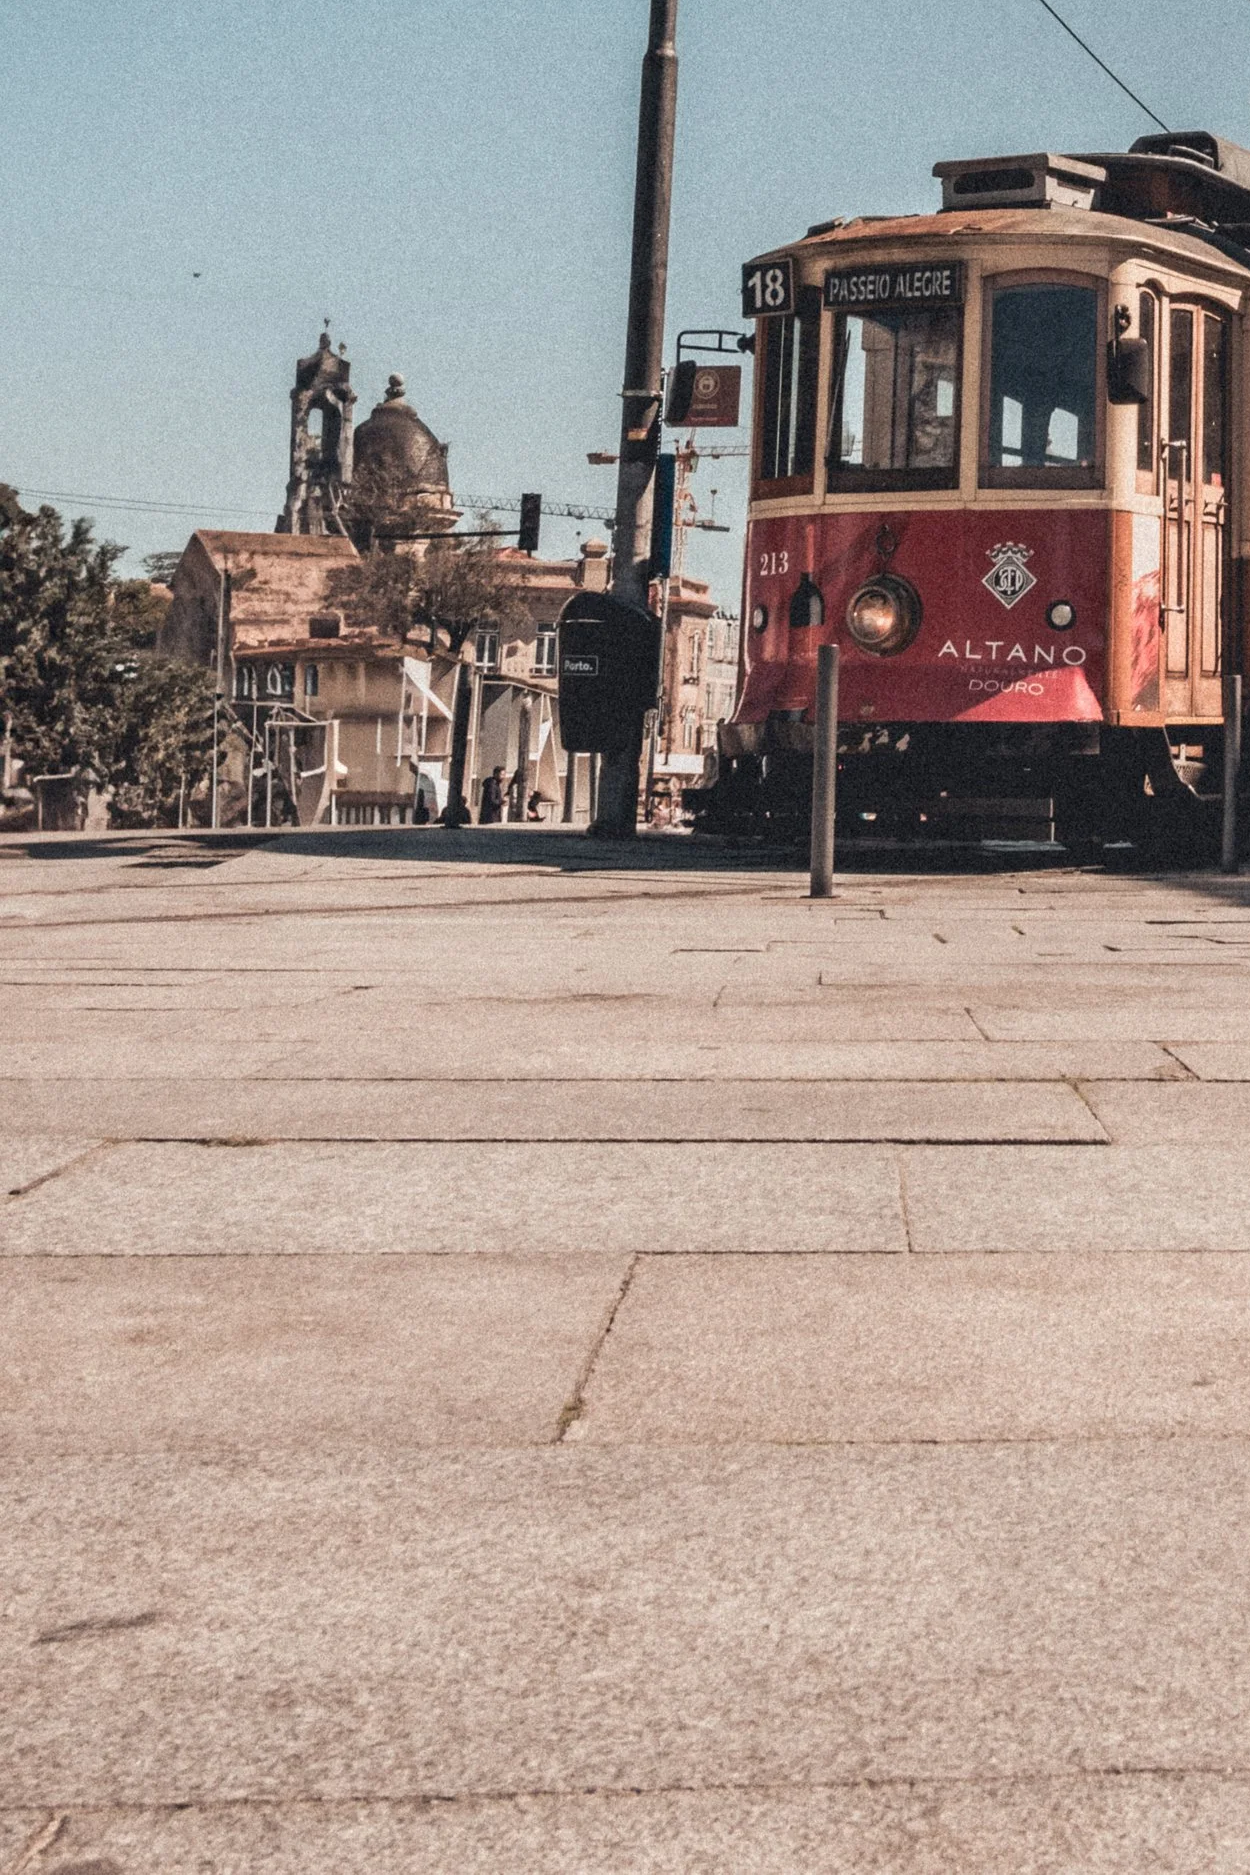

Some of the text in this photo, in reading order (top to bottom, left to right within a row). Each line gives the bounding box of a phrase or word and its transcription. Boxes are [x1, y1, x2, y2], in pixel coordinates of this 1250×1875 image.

[748, 268, 785, 309] 18
[829, 269, 951, 303] PASSEIO ALEGRE
[760, 550, 789, 576] 213
[938, 639, 1086, 665] ALTANO
[968, 679, 1044, 696] DOURO
